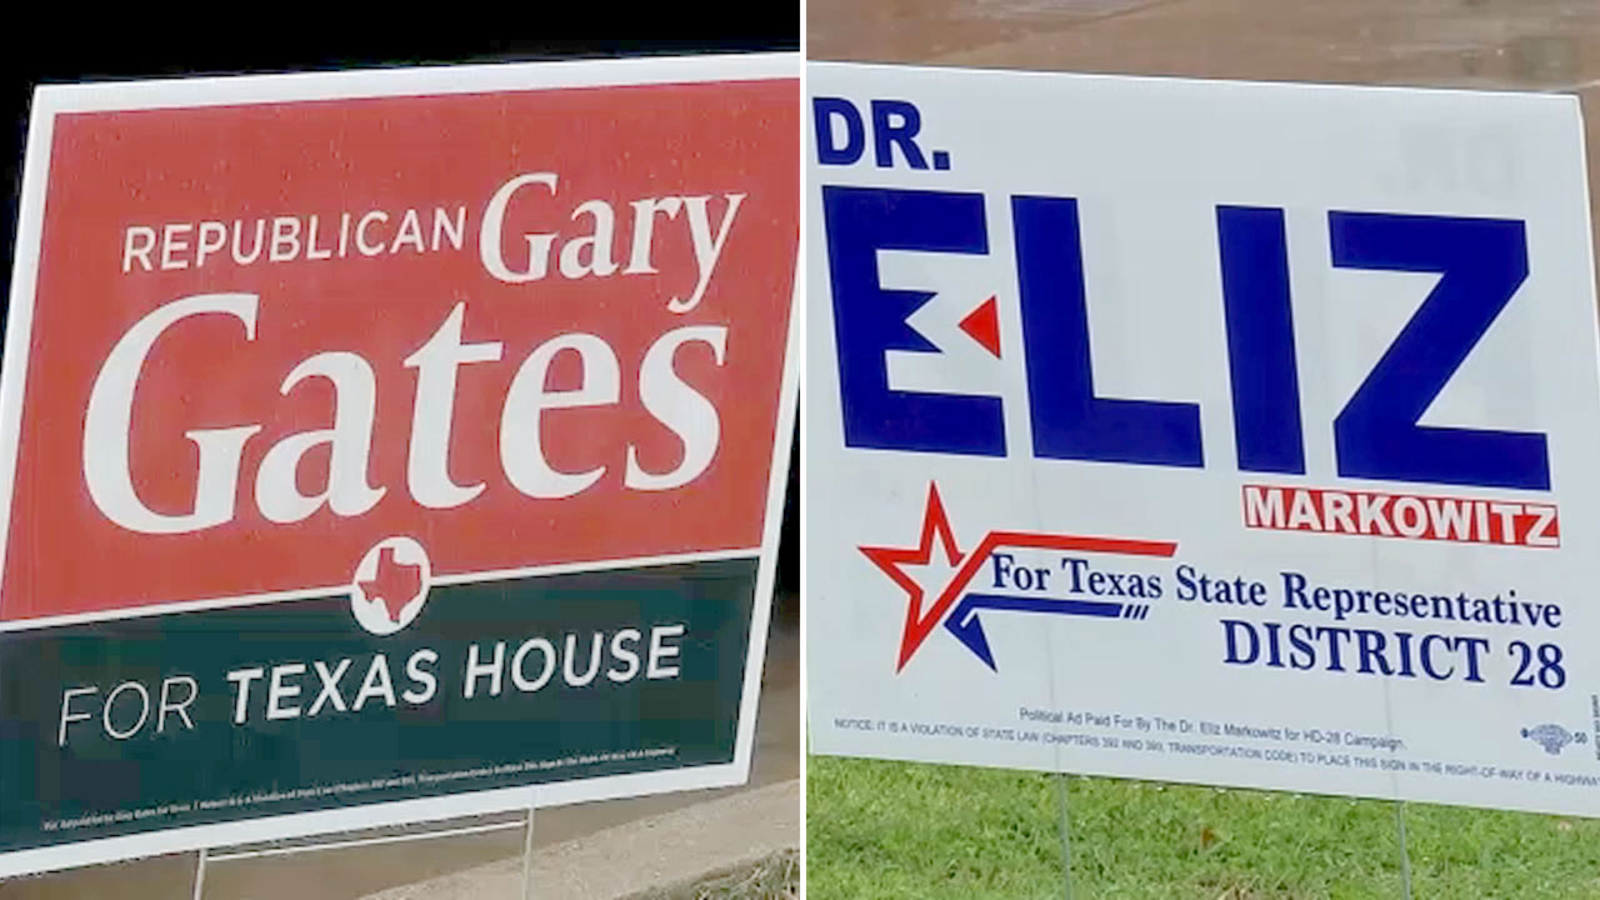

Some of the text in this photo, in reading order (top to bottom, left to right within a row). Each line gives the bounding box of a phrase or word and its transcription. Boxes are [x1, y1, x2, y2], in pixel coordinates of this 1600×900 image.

[812, 96, 951, 171] DR.
[122, 172, 747, 314] REPUBLICAN Gary
[821, 184, 1552, 492] ELIZ
[82, 293, 729, 535] Gates
[1243, 486, 1560, 547] MARKOWITZ
[990, 553, 1562, 629] For Texas State Representative
[57, 624, 687, 746] FOR TEXAS HOUSE
[1221, 619, 1567, 689] DISTRICT 28
[910, 723, 964, 736] VIOLATION
[982, 727, 1015, 741] STATE
[1019, 706, 1063, 723] Political
[1067, 711, 1082, 725] Ad
[1085, 712, 1110, 727] Paid
[1113, 714, 1133, 728] For
[1136, 717, 1151, 732] By
[1155, 717, 1176, 731] The
[1179, 719, 1196, 733] Dr.
[1200, 722, 1221, 735] Eliz
[1224, 723, 1281, 740] Markowitz
[1284, 728, 1300, 741] for
